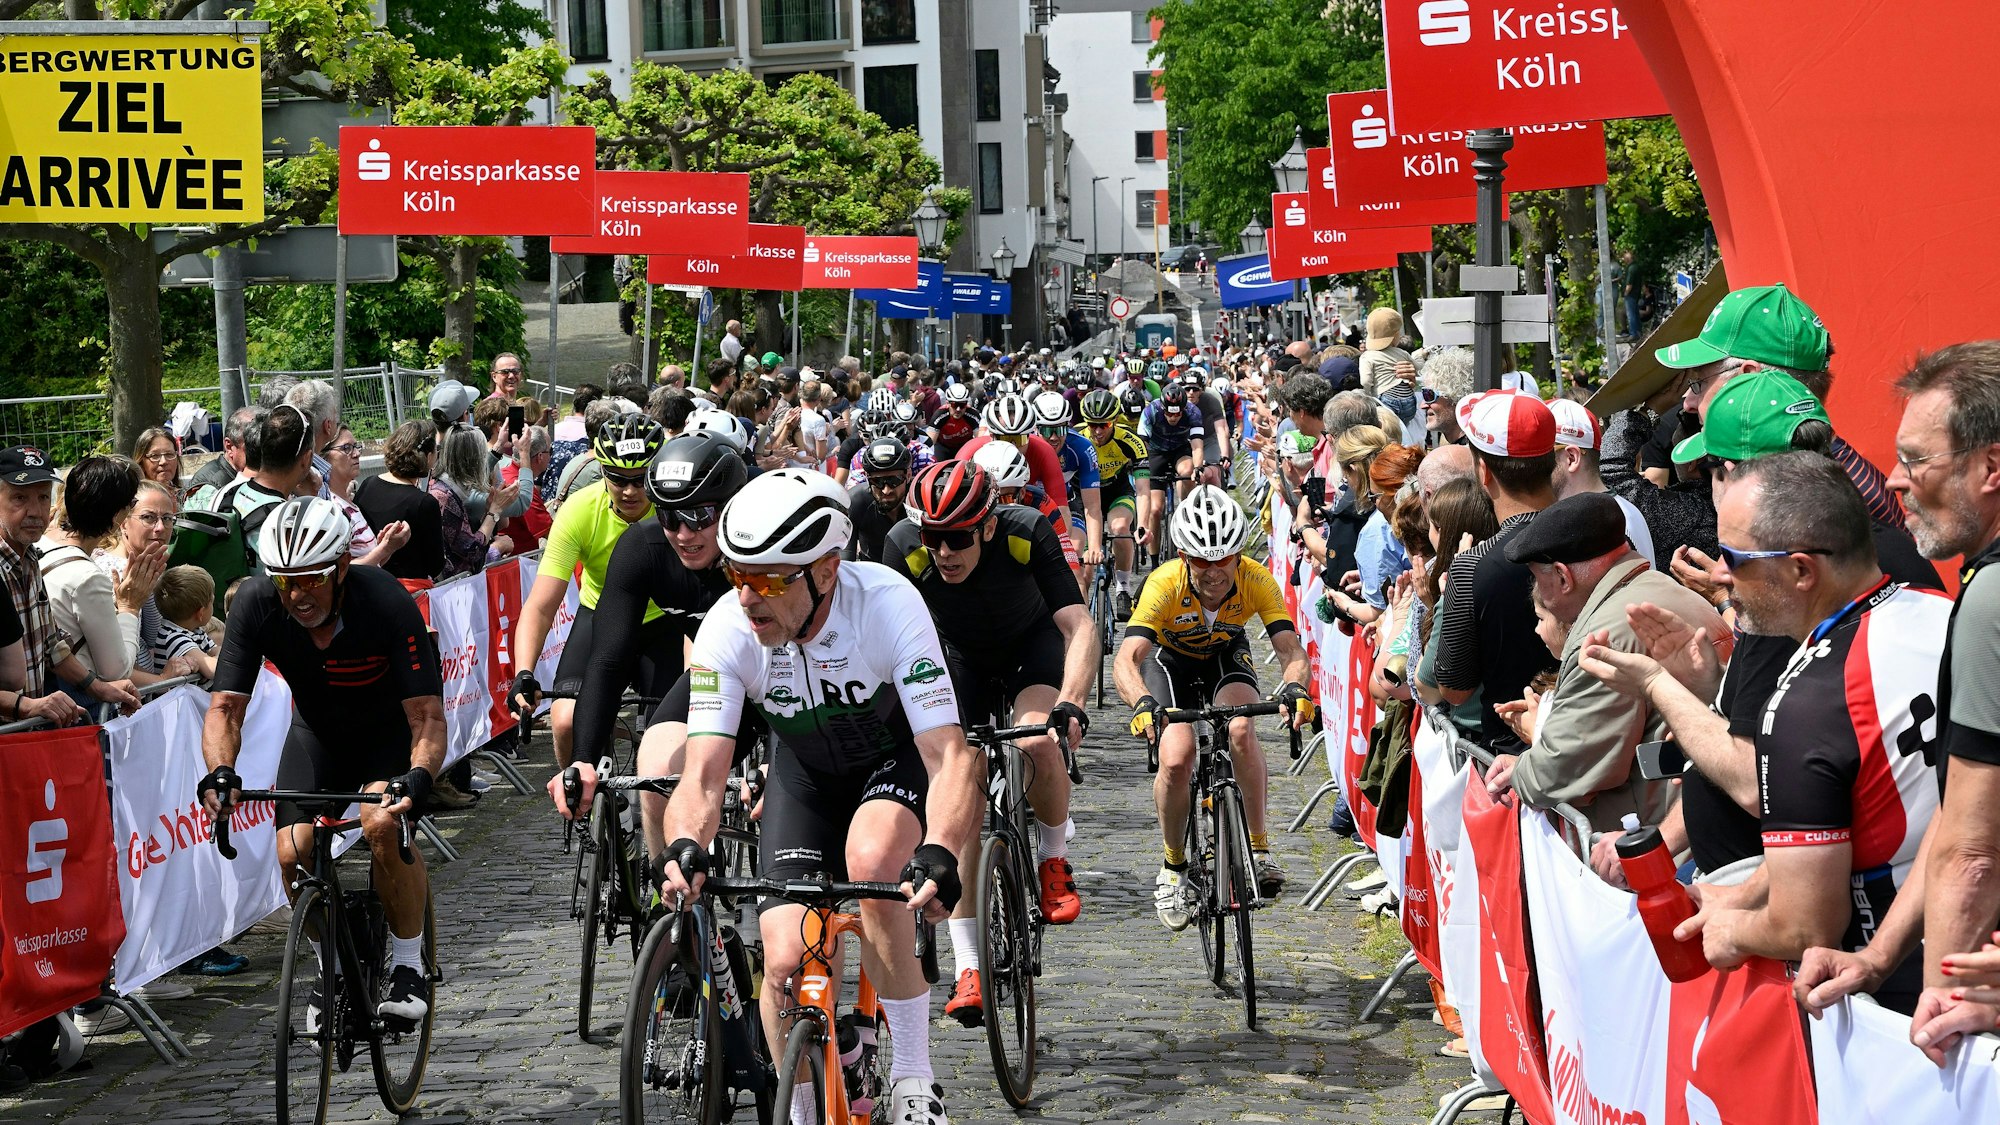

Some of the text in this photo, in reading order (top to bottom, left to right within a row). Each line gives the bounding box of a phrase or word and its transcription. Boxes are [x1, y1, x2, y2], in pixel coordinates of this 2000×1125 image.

[1496, 53, 1581, 90] Köln
[58, 81, 182, 134] ZIEL
[403, 159, 580, 186] Kreissparkasse
[1403, 152, 1459, 177] Köln
[0, 145, 243, 210] ARRIVÈE
[403, 190, 455, 212] Köln
[601, 196, 738, 217] Kreissparkasse
[601, 220, 641, 237] Köln
[1314, 230, 1346, 243] Köln
[687, 259, 719, 273] Köln
[824, 251, 912, 267] Kreissparkasse
[824, 266, 851, 278] Köln
[620, 441, 641, 452] 2103
[1204, 549, 1225, 558] 5079
[819, 679, 872, 710] RC
[895, 788, 918, 805] e.V.
